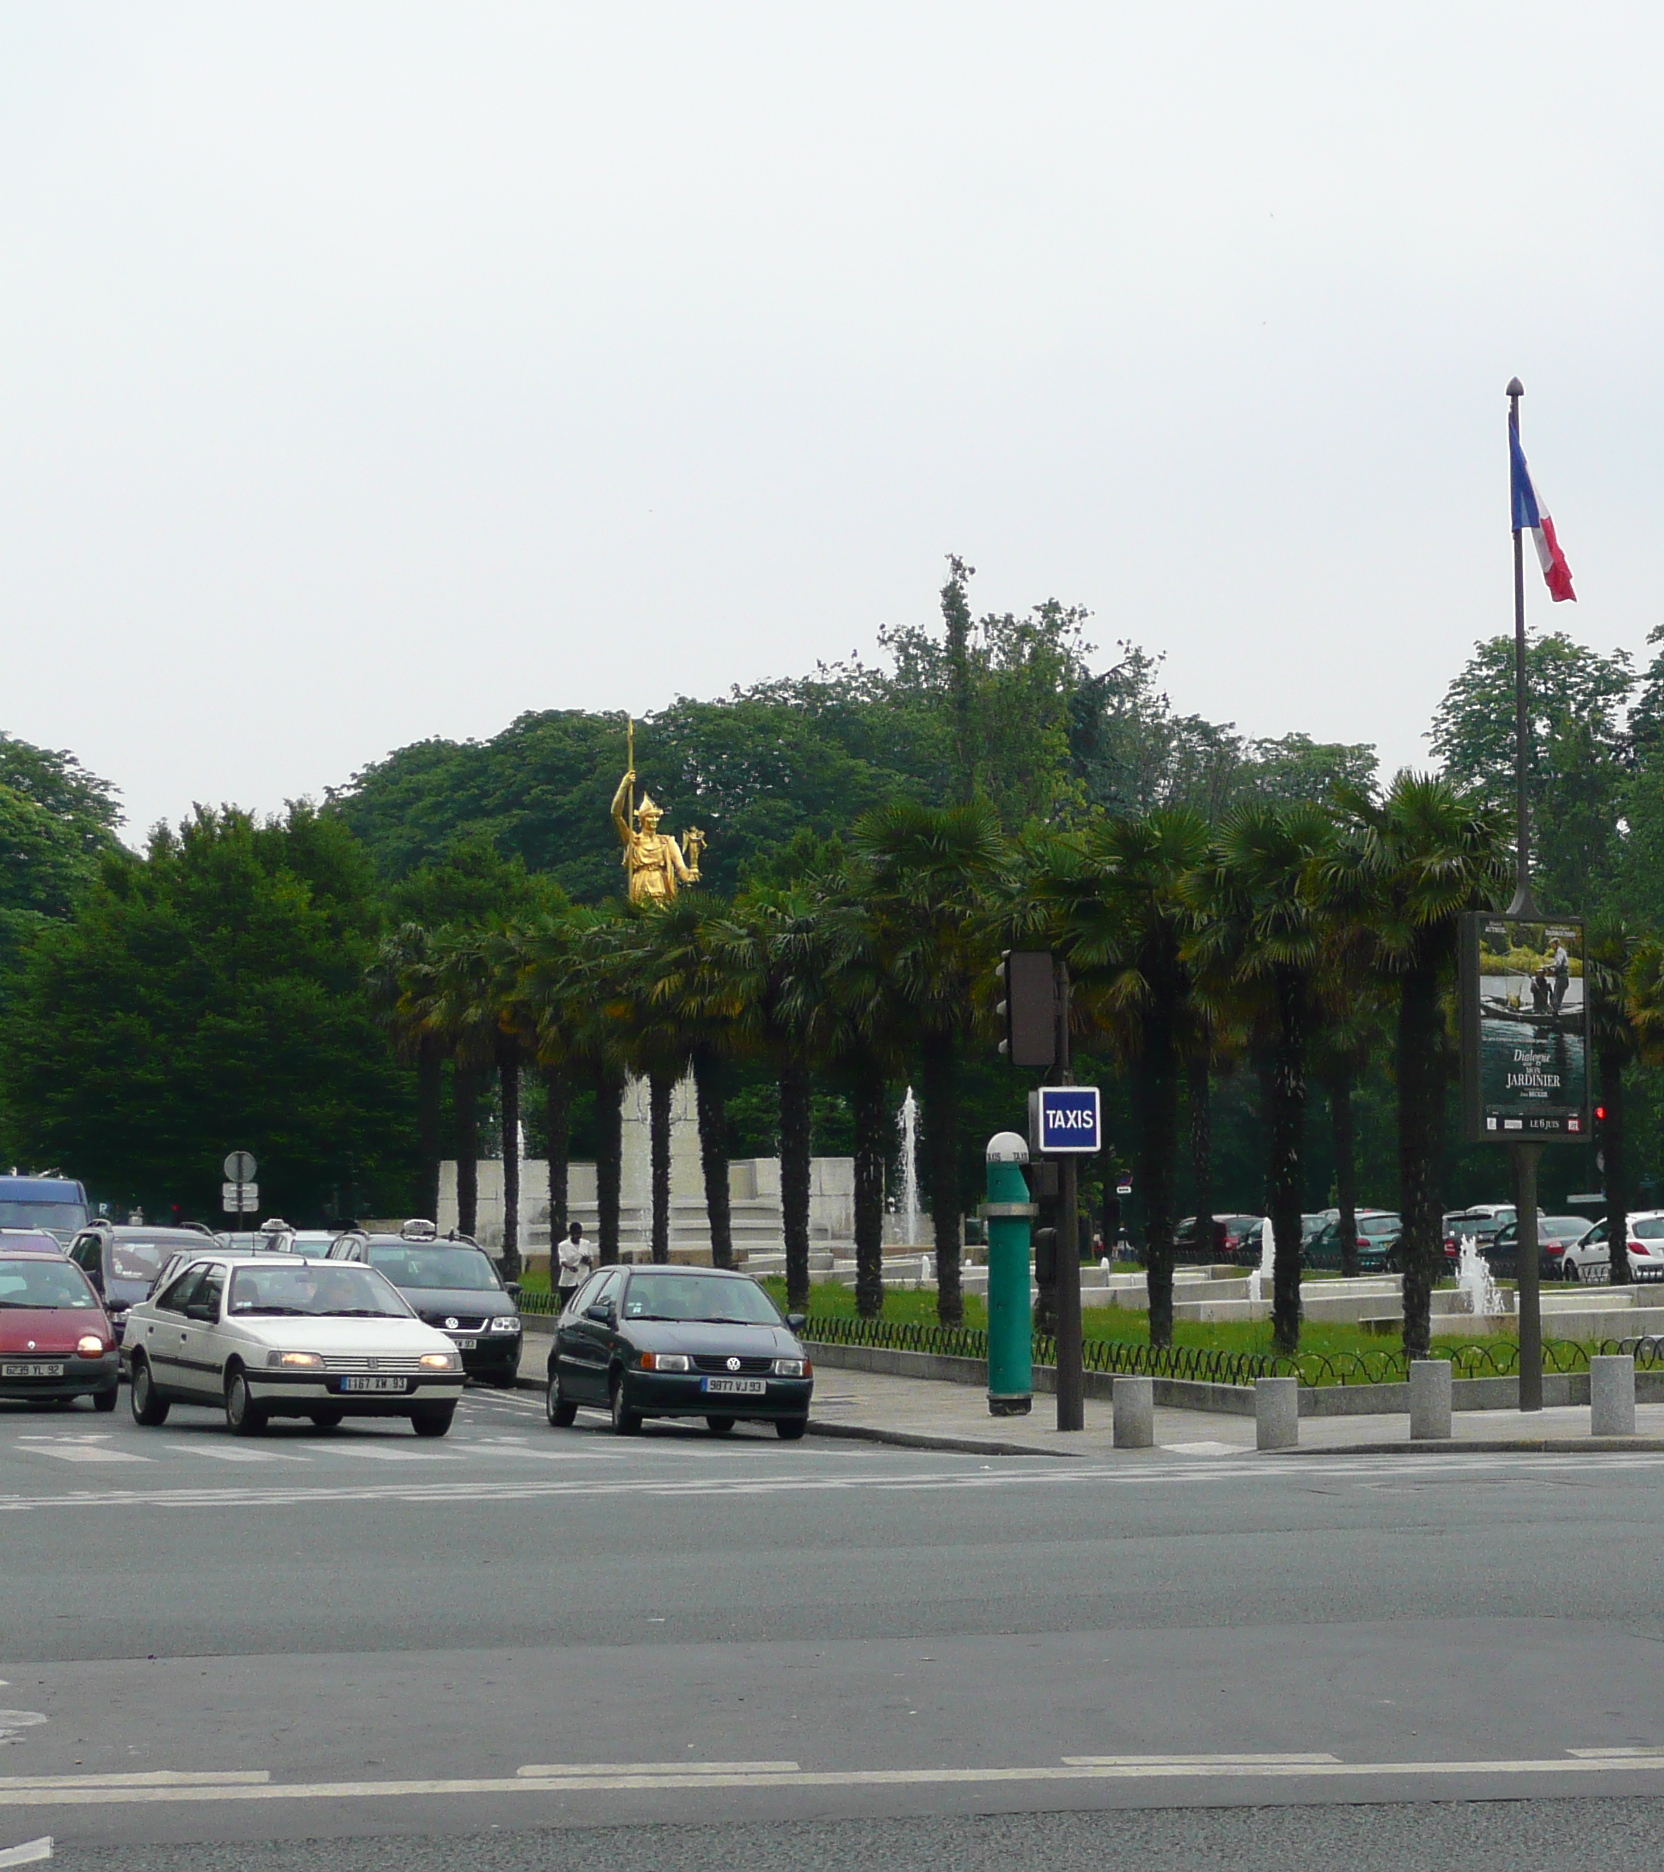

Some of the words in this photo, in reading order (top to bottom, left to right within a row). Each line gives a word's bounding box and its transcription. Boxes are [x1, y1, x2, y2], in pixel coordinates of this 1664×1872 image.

[1513, 1049, 1551, 1066] Dialogue
[1505, 1073, 1561, 1089] JARDINIER
[1046, 1110, 1094, 1129] TAXIS
[33, 1365, 44, 1375] YL
[48, 1365, 60, 1375] 92
[393, 1378, 405, 1390] 93
[749, 1381, 761, 1393] 93
